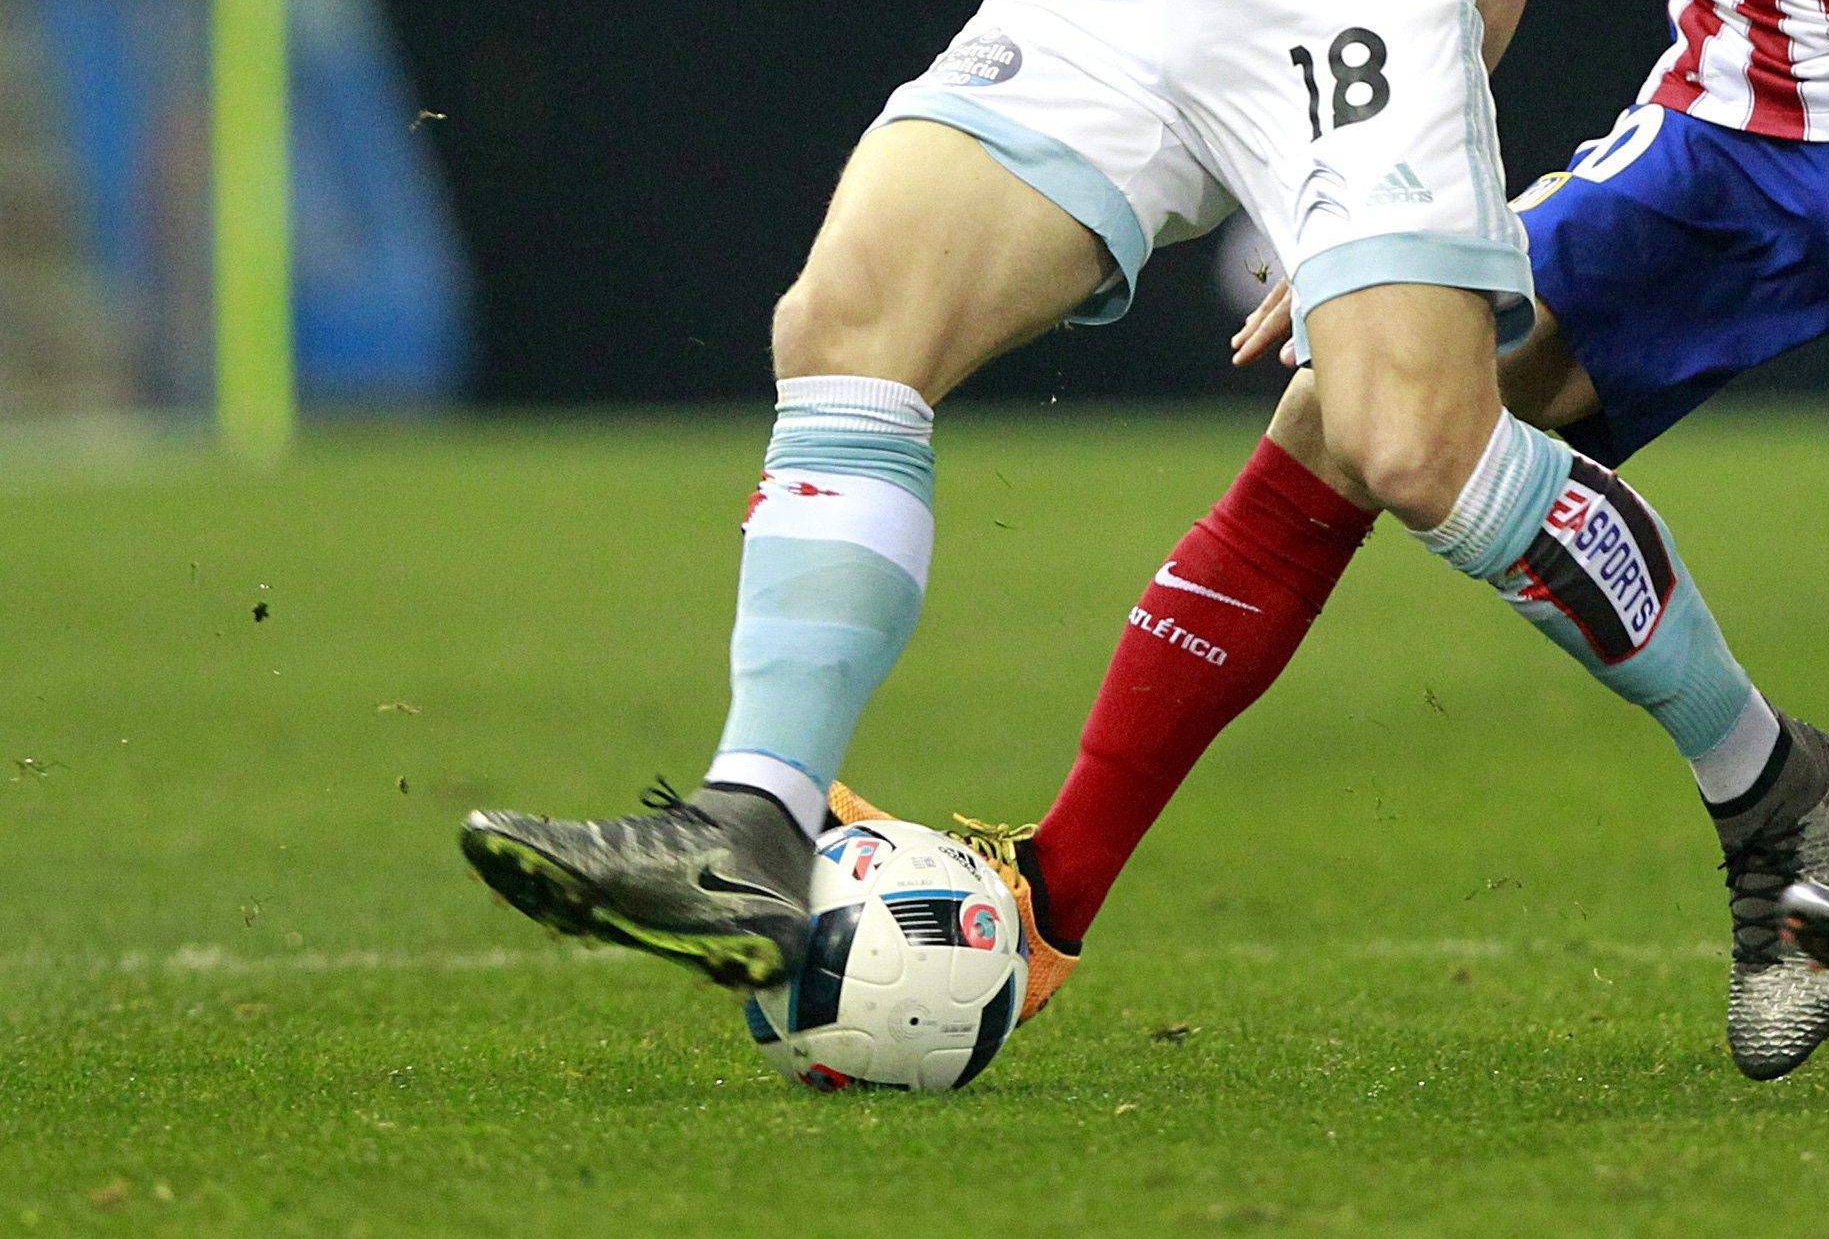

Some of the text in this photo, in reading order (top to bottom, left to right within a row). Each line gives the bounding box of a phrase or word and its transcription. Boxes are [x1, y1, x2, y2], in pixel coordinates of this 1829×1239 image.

[1289, 26, 1391, 144] 18
[1546, 489, 1655, 633] EA SPORTS
